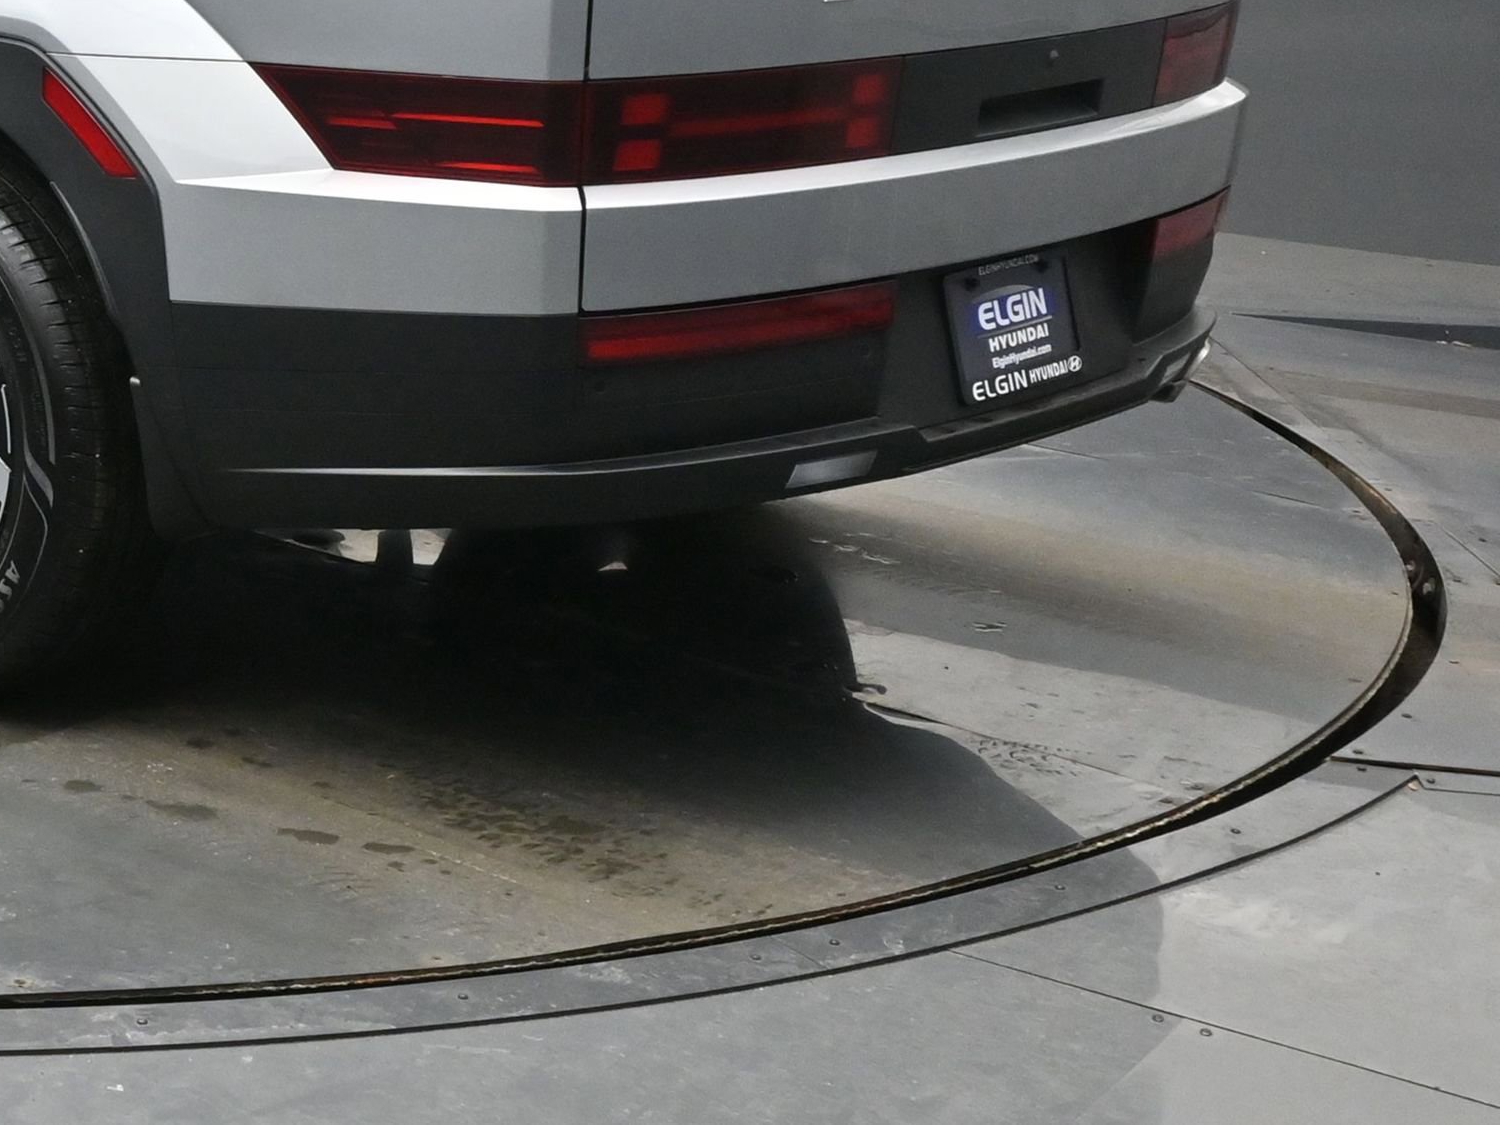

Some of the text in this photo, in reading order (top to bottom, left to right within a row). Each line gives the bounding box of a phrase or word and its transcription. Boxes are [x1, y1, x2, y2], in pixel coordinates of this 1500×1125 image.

[978, 288, 1047, 330] ELGIN
[989, 323, 1049, 352] HYUNDAI
[973, 360, 1068, 401] ELGIN HYUNDAI
